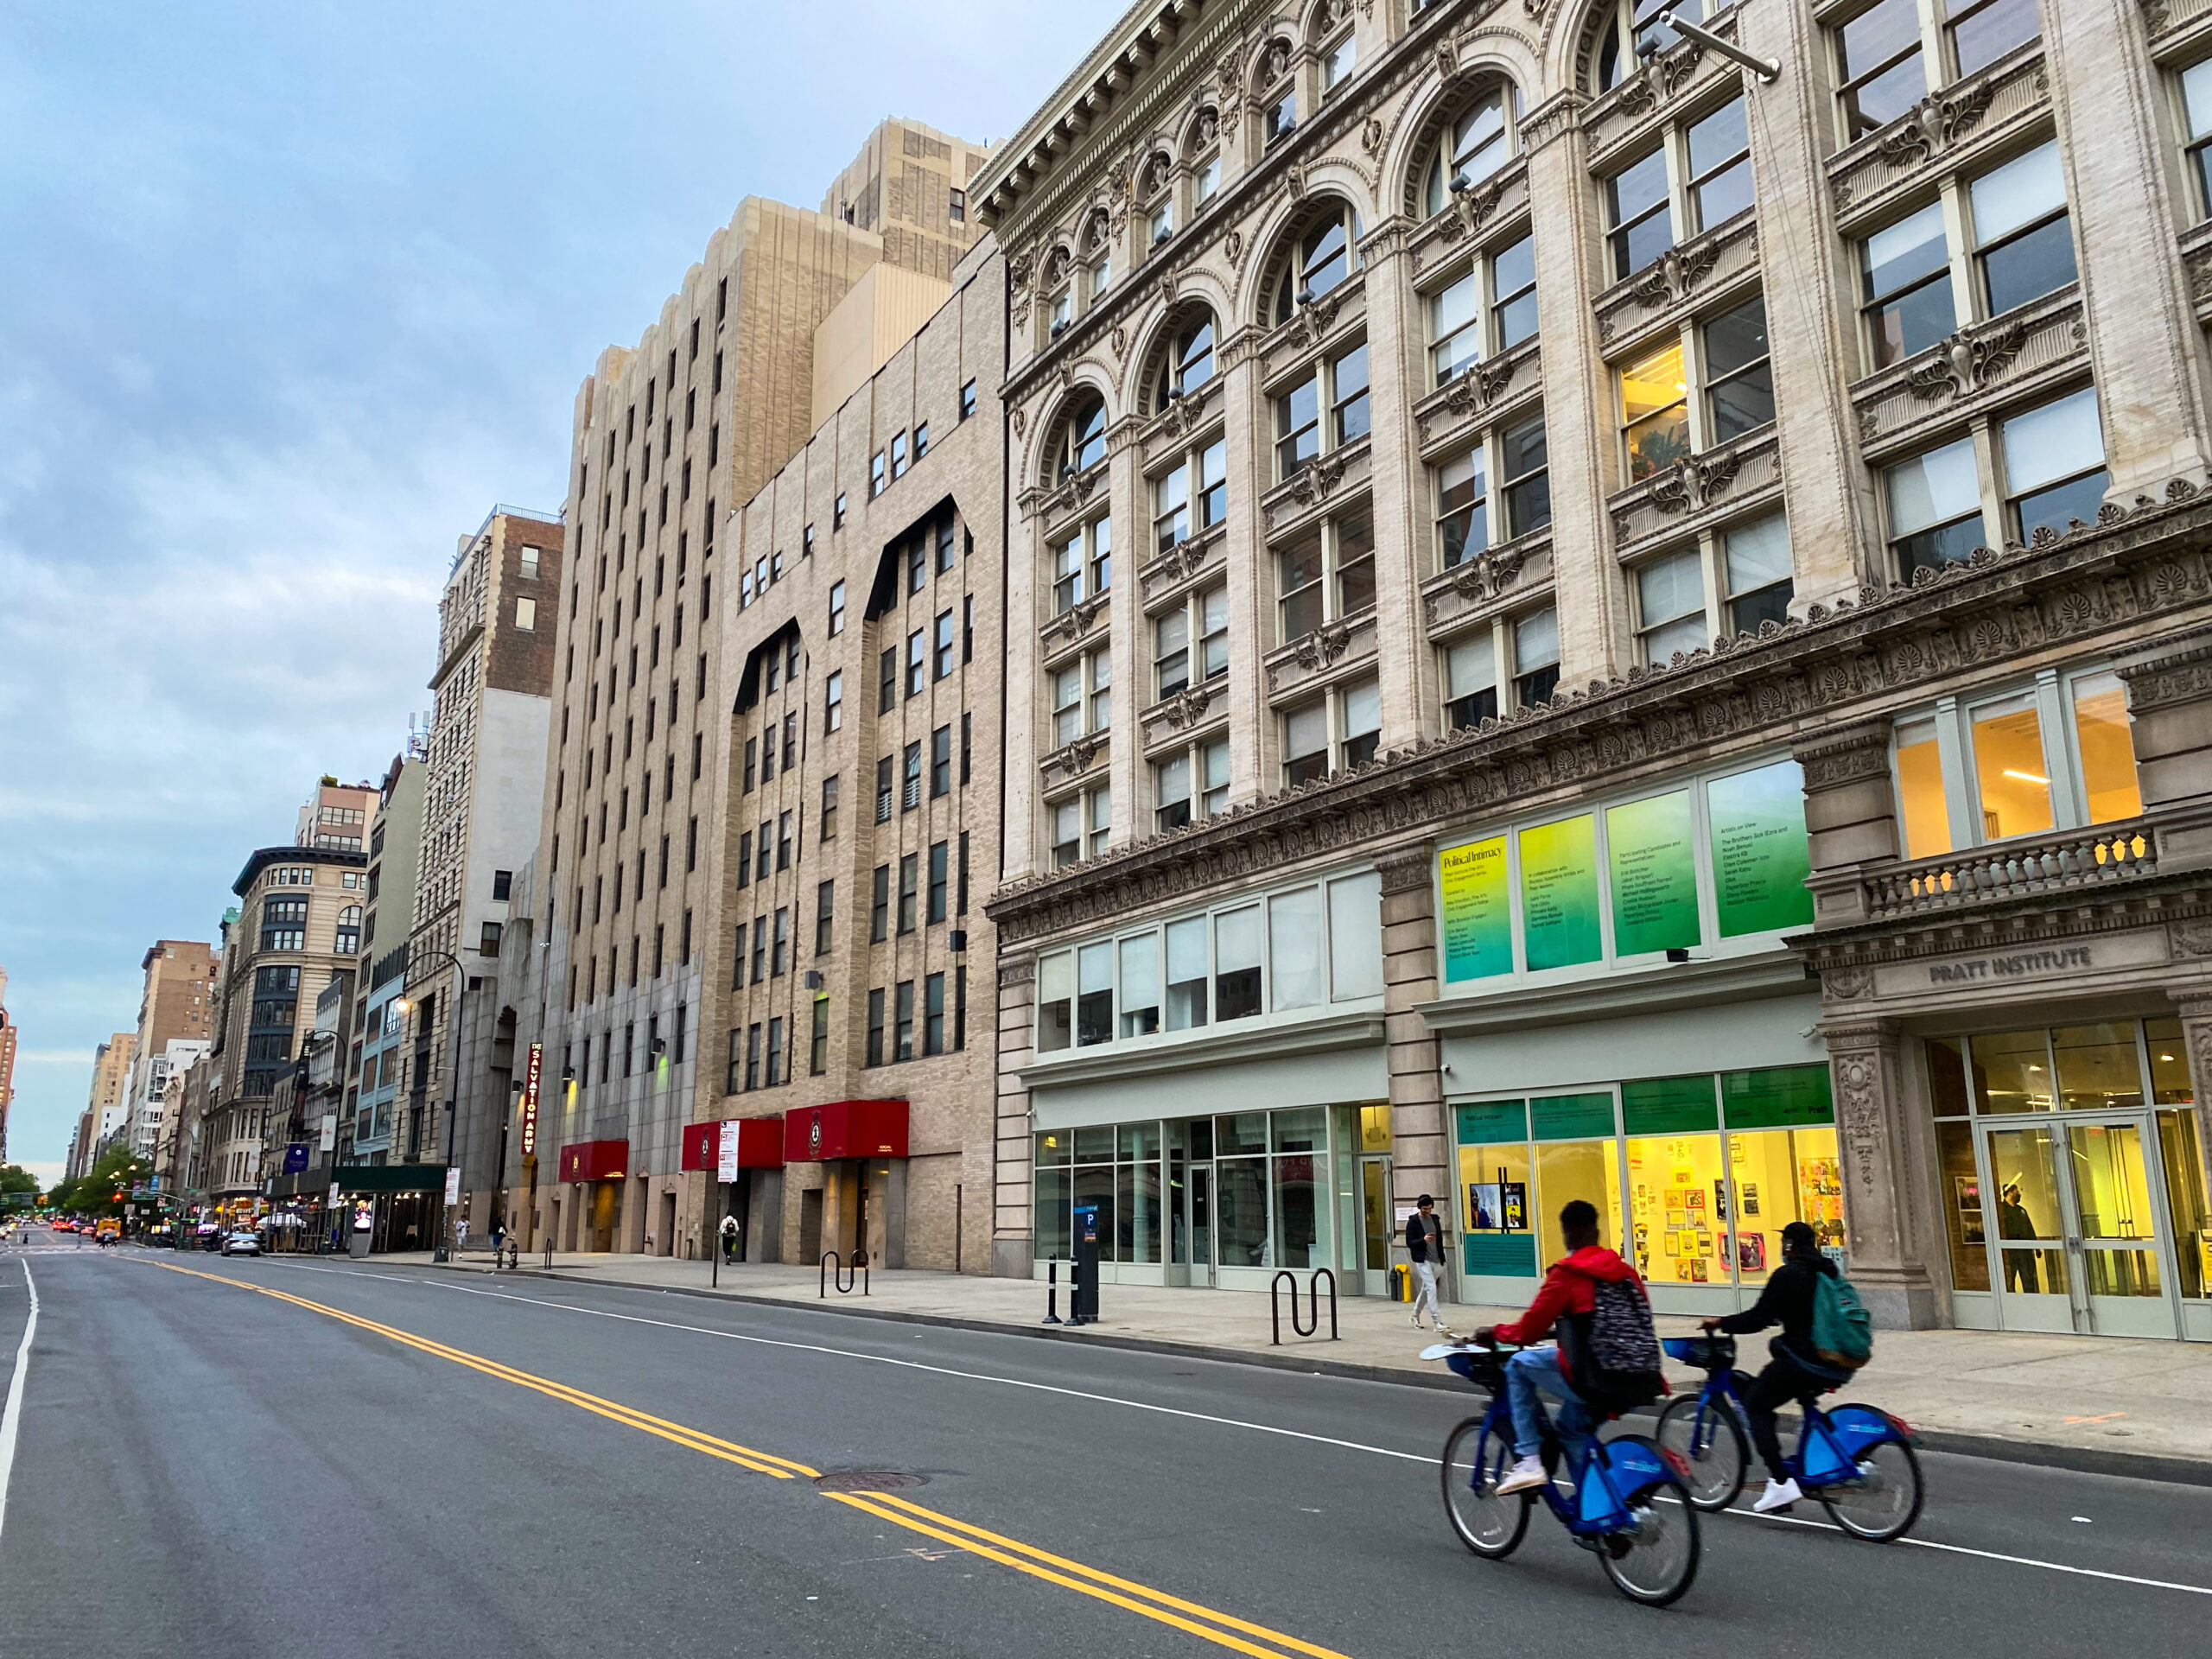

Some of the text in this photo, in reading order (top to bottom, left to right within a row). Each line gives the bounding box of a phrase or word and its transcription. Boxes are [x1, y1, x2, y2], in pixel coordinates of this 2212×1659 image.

[1647, 843, 1672, 852] Candidates
[1444, 848, 1503, 868] Political Intimacy
[1929, 946, 2091, 982] PRATT INSTITUTE
[524, 1051, 540, 1153] SALVATION ARMY
[1087, 1214, 1094, 1225] P
